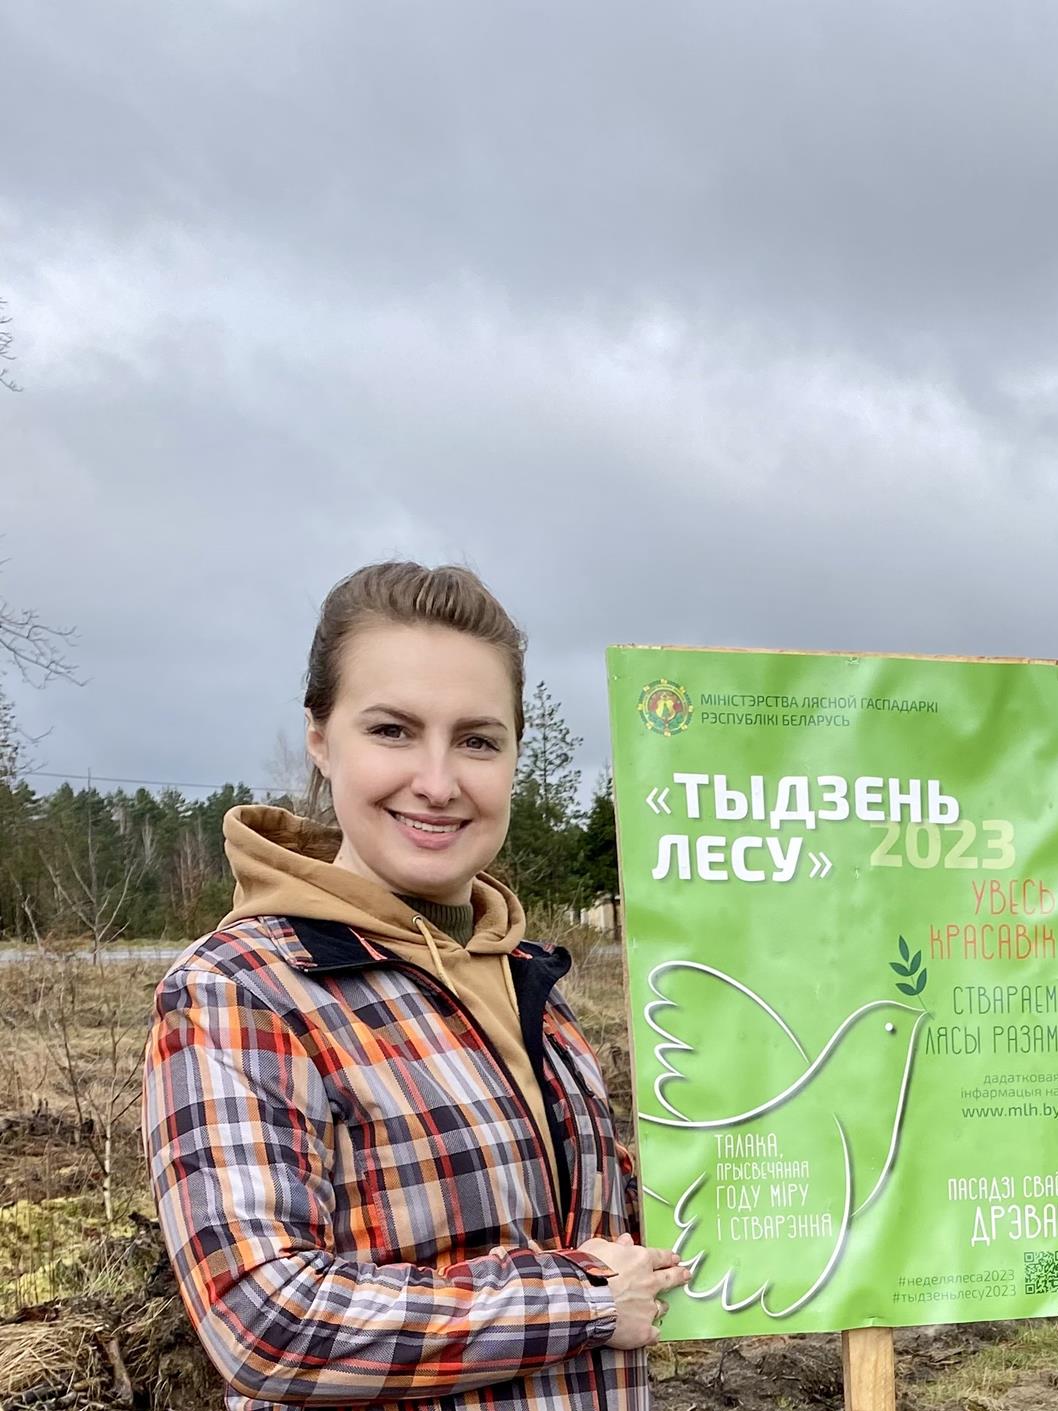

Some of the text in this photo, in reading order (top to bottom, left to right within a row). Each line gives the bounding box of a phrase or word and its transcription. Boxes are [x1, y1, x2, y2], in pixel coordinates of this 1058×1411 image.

[700, 693, 938, 713] МІНІСТЭРСТВА ЛЯСНОЙ ГАСПАДАРКІ
[701, 712, 850, 727] РЭСПУБЛІКІ БЕЛАРУСЬ
[646, 772, 960, 830] «ТЫДЗЕНЬ
[651, 834, 833, 882] ЛЕСУ»
[869, 818, 1016, 870] 2023
[972, 879, 1056, 915] УВЕСЬ
[929, 923, 1056, 961] КРАСАВІК
[953, 985, 1057, 1015] СТВАРАЕМ
[925, 1025, 1058, 1055] ЛЯСЫ РАЗАМ
[960, 1088, 1042, 1100] інфармацыя
[714, 1133, 783, 1159] ТАЛАКА,
[716, 1161, 810, 1181] ПРЫСВЕЧАНАЯ
[716, 1181, 809, 1212] ГОДУ МІРУ
[948, 1176, 1015, 1202] ПАСАДЗІ
[730, 1213, 832, 1241] СТВАРЭННЯ
[898, 1269, 1015, 1288] #неделялеса2023
[892, 1285, 1017, 1304] #тыдзеньлесу2023
